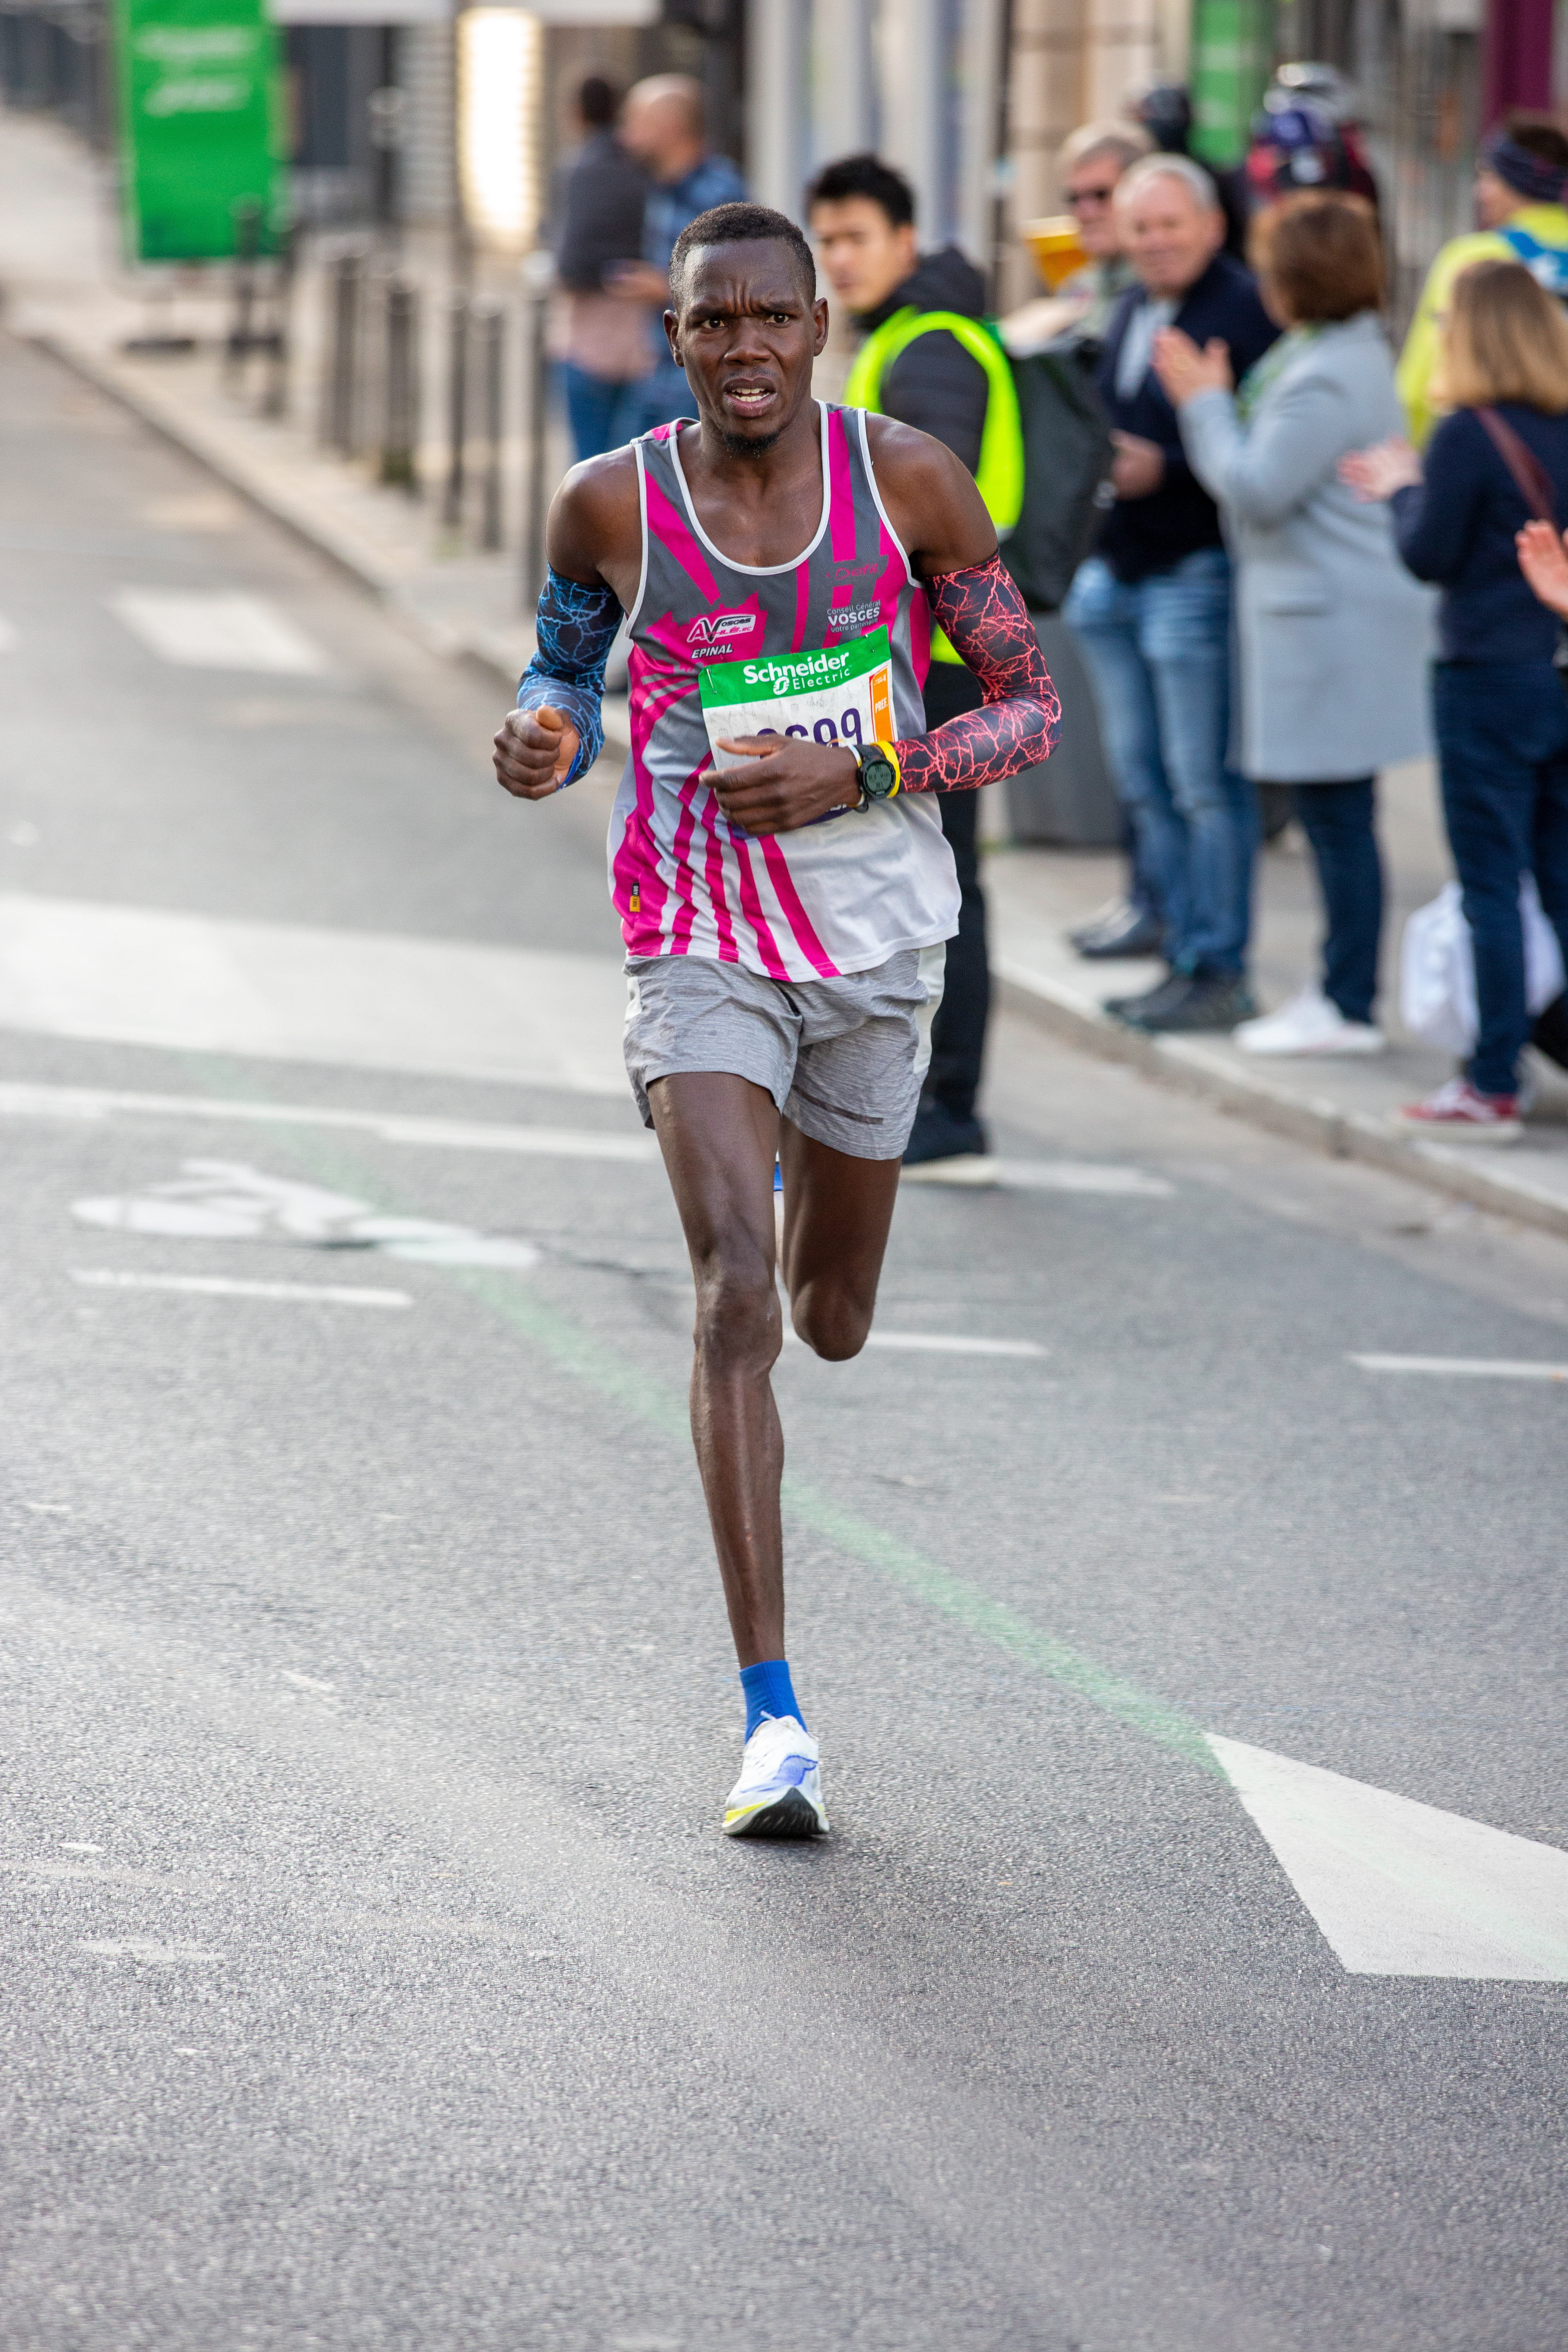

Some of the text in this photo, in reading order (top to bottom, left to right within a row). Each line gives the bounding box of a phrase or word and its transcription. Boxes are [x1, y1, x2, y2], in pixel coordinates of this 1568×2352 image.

[827, 600, 881, 615] Conseil Général
[828, 607, 880, 626] VOSGES
[831, 625, 849, 633] votre
[691, 643, 733, 659] EPINAL
[743, 652, 849, 684] Schneider
[793, 668, 851, 690] Electric
[875, 697, 888, 714] PREF.
